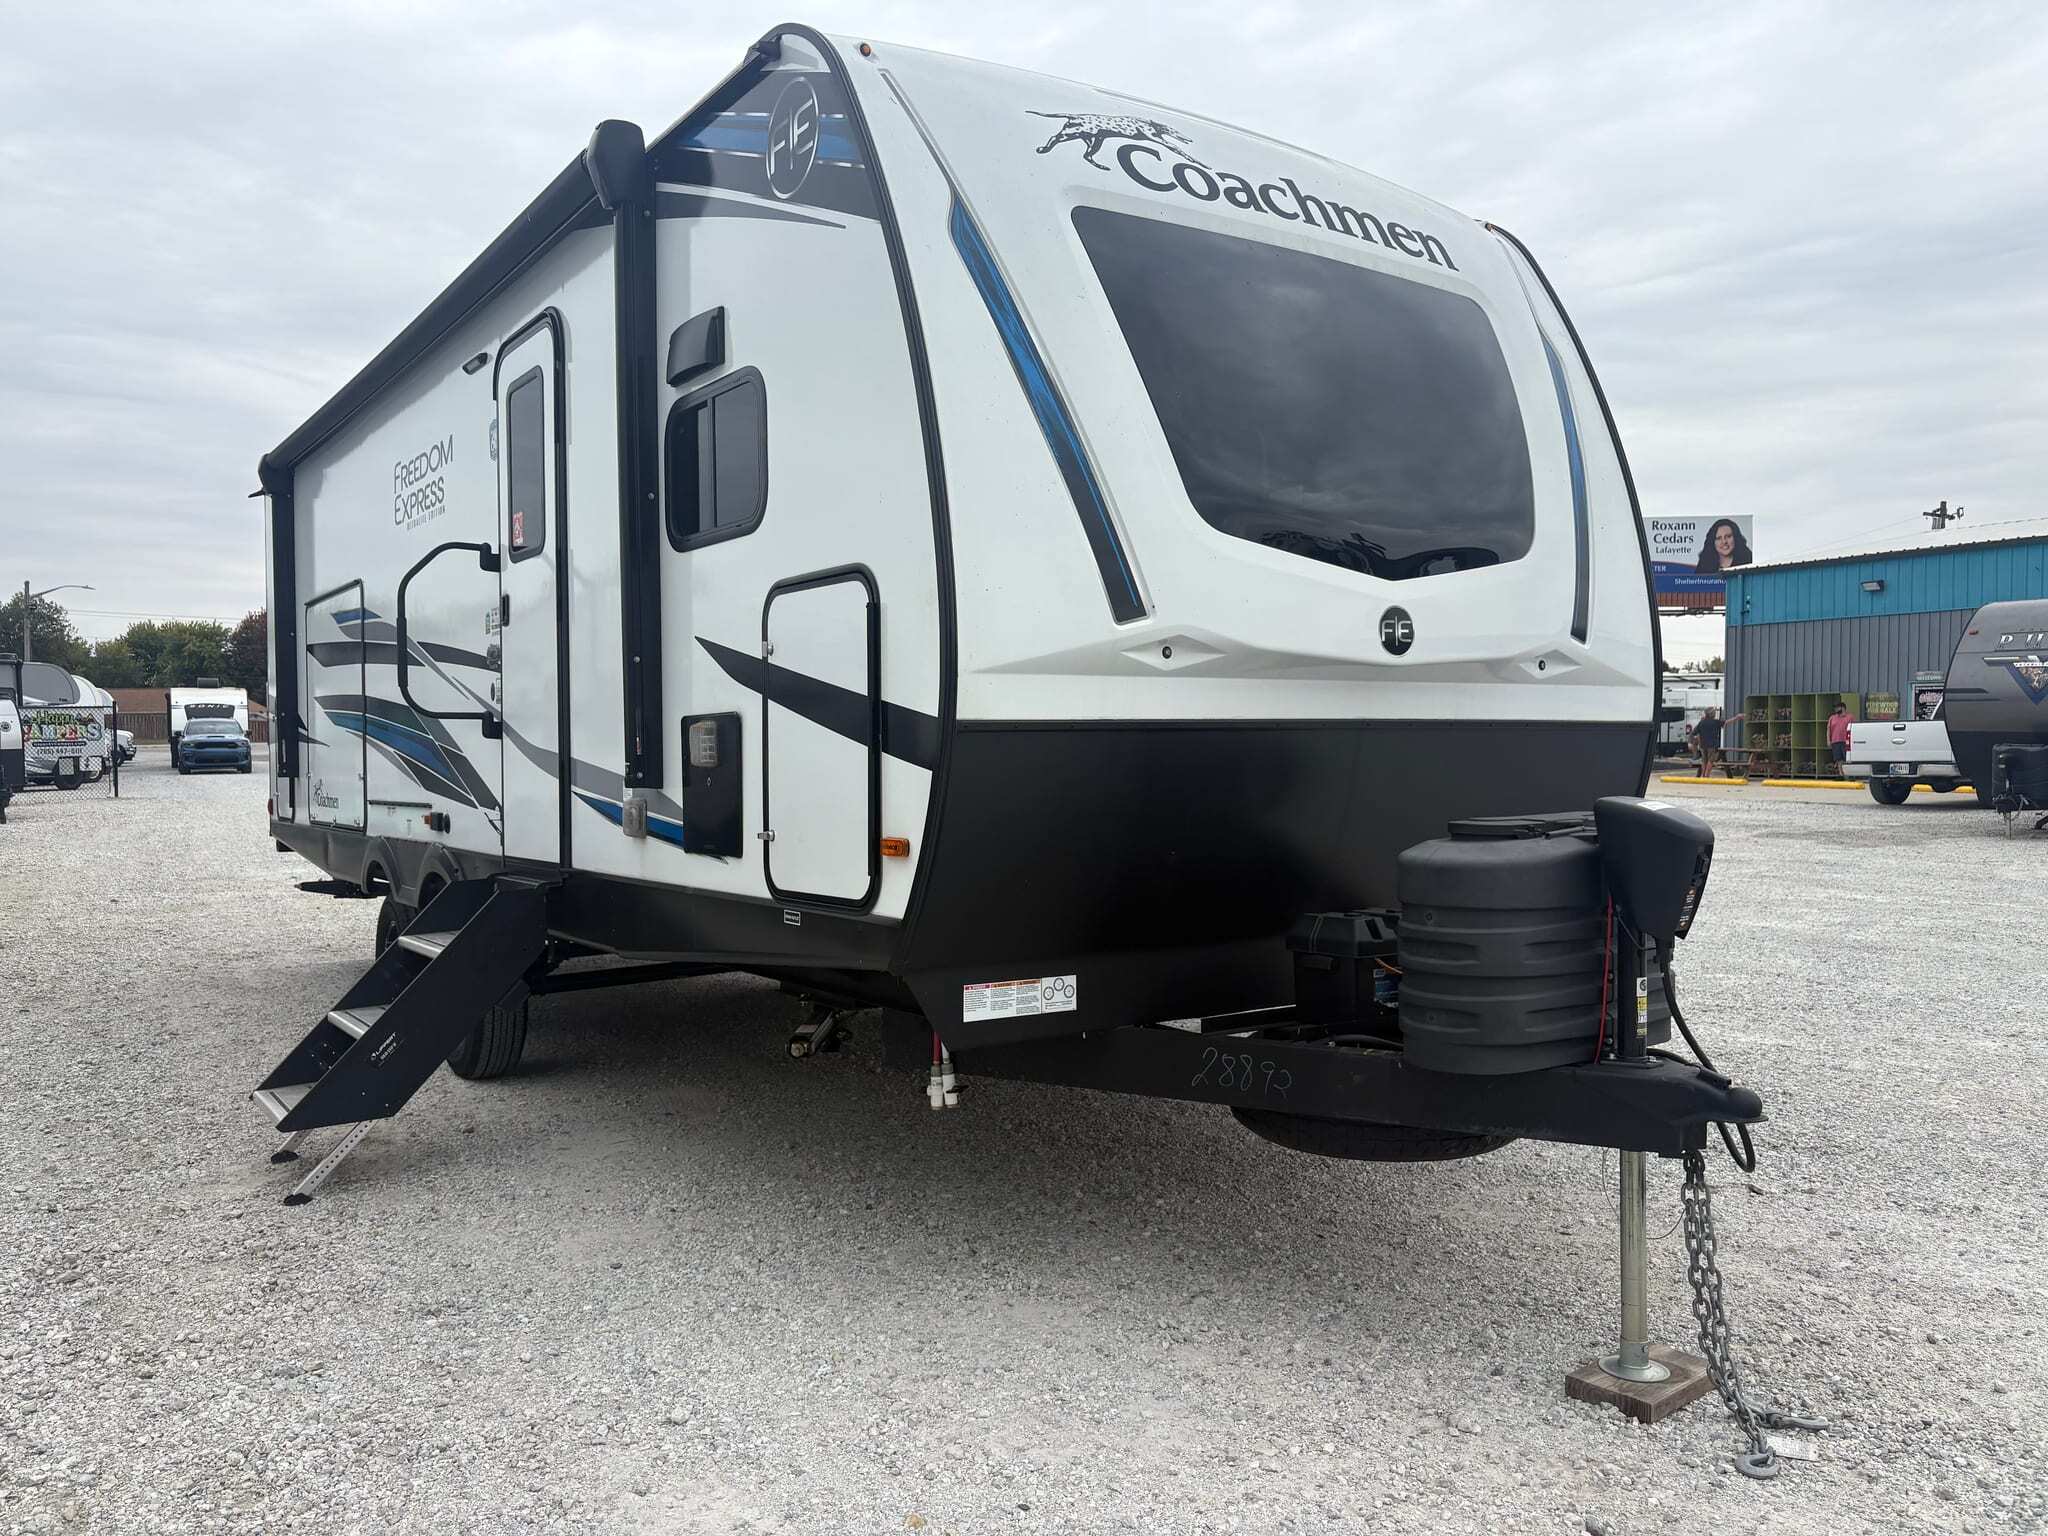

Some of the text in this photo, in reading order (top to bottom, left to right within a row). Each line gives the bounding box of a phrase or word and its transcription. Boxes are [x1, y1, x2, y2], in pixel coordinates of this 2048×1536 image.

[1116, 144, 1460, 272] Coachmen
[394, 434, 454, 494] FREEDOM
[394, 476, 445, 526] EXPRESS
[1652, 520, 1696, 531] Roxann
[1655, 546, 1692, 555] Lafayette
